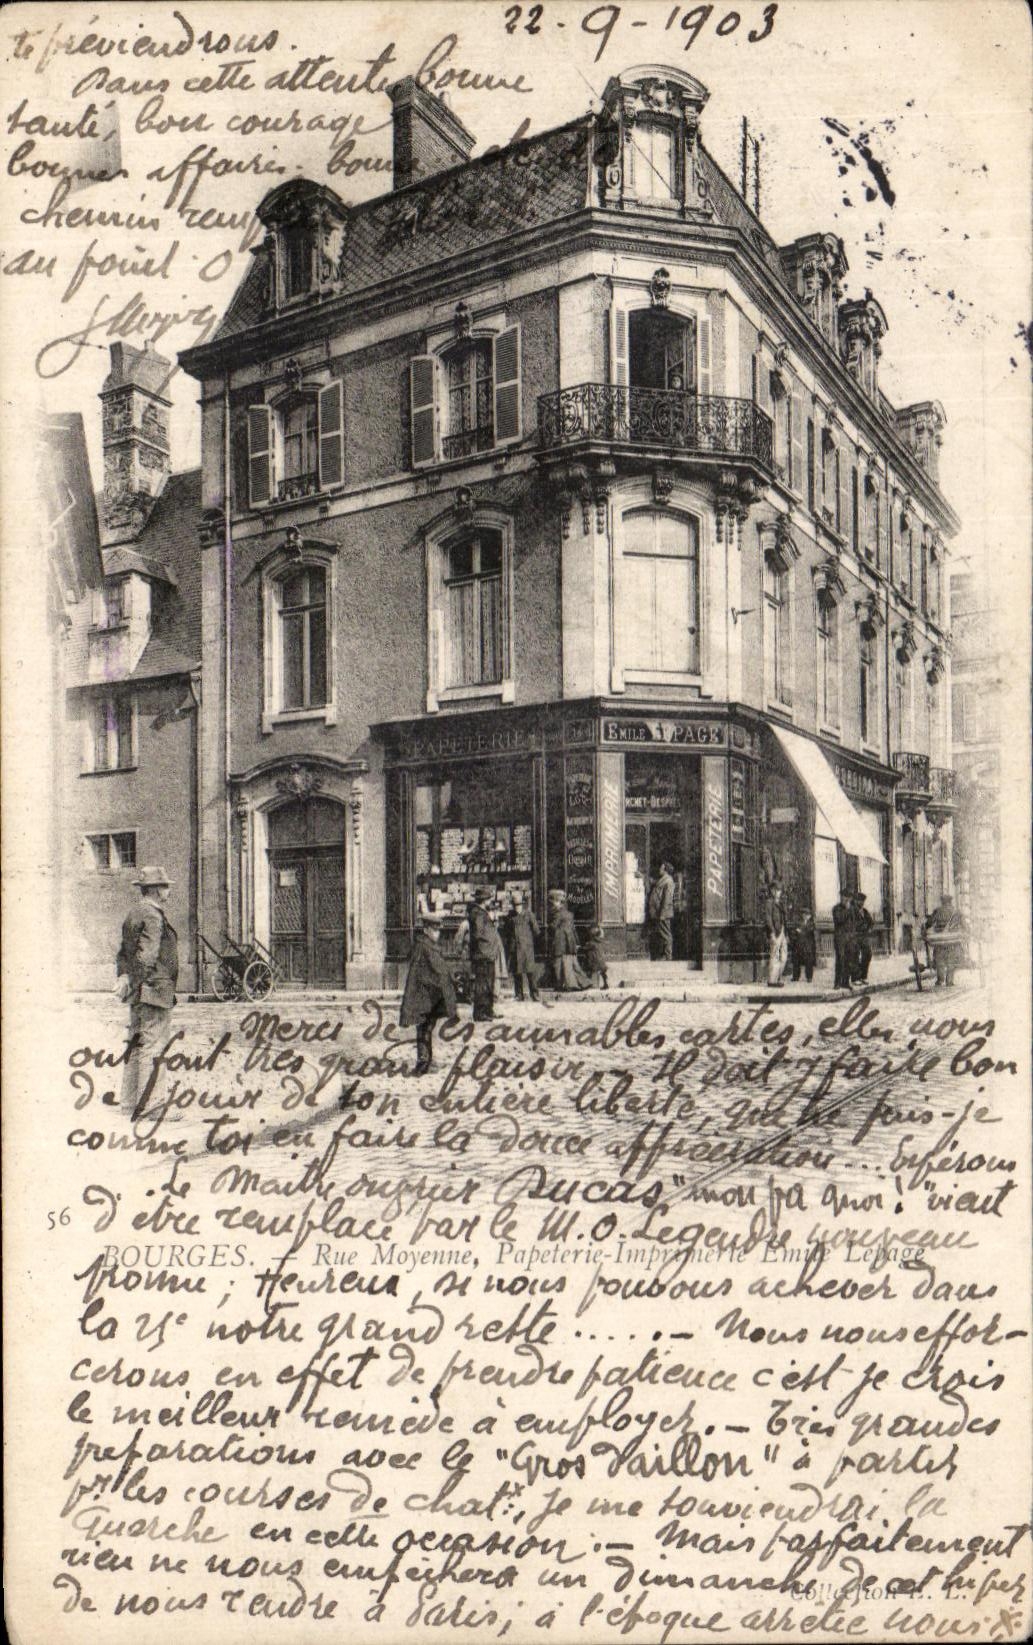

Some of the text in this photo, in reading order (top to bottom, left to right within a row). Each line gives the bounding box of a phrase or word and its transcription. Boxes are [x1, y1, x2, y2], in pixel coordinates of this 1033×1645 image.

[183, 59, 256, 91] cette
[135, 95, 215, 134] bon
[652, 723, 720, 744] PAGE
[603, 777, 622, 900] IMPRIMERIE
[706, 783, 725, 899] PAPETERIE
[910, 1015, 996, 1042] nous
[68, 1032, 145, 1068] ont
[949, 1037, 1018, 1078] bon
[68, 1069, 120, 1111] de
[281, 1075, 318, 1111] de
[433, 1117, 472, 1153] la
[489, 1201, 519, 1242] le
[484, 1273, 567, 1298] nous
[78, 1296, 119, 1342] la
[215, 1365, 263, 1388] en
[386, 1342, 425, 1387] de
[66, 1389, 93, 1423] le
[441, 1437, 475, 1474] le
[326, 1467, 389, 1513] de
[248, 1520, 292, 1544] en
[205, 1552, 304, 1579] nous
[52, 1572, 97, 1614] de
[114, 1592, 209, 1616] nous
